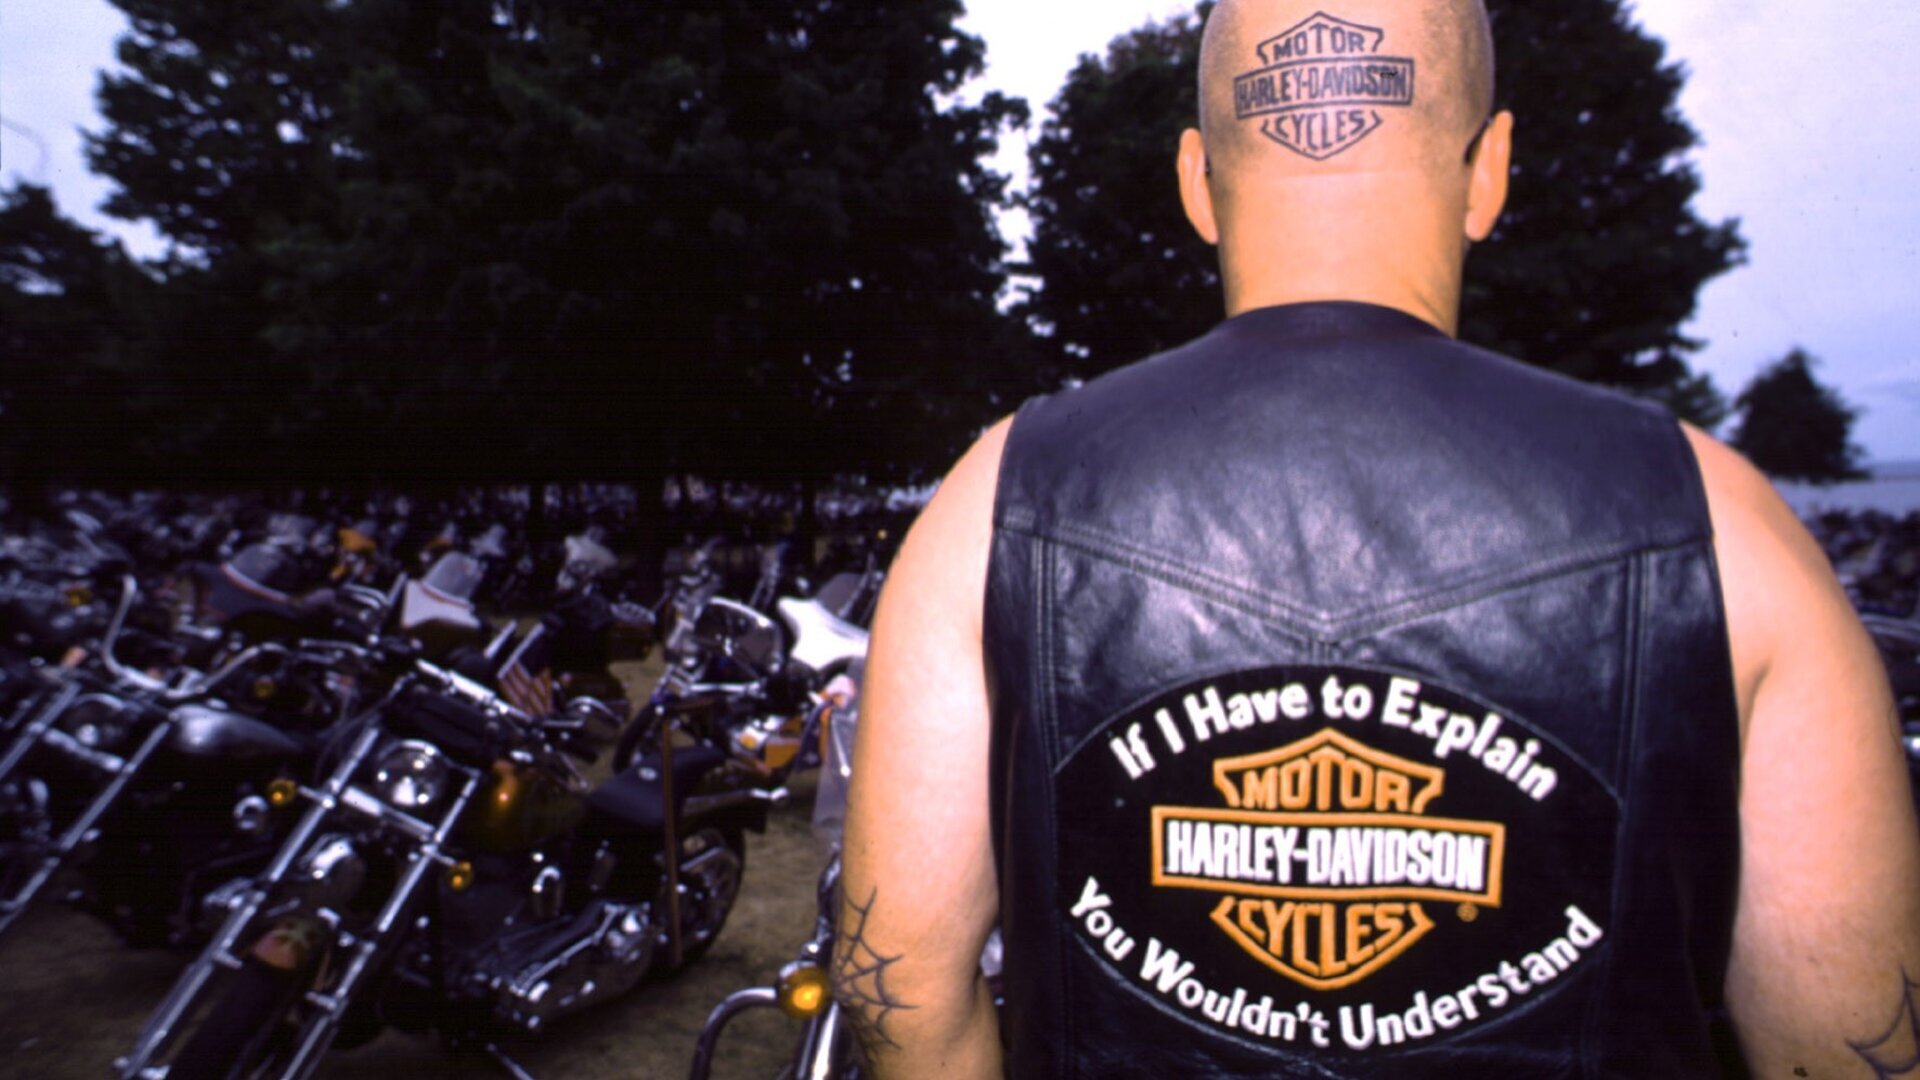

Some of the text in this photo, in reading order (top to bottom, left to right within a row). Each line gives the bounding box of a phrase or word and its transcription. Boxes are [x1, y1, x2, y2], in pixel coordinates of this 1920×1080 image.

[1273, 22, 1366, 61] MOTOR
[1236, 65, 1407, 113] HARLEY-DAVIDSON
[1275, 110, 1365, 151] CYCLES
[1110, 676, 1558, 800] If I Have to Explain
[1242, 745, 1411, 812] MOTOR
[1166, 819, 1486, 892] HARLEY-DAVIDSON
[1069, 876, 1603, 1050] You Wouldn't Understand
[1238, 899, 1406, 977] CYCLES
